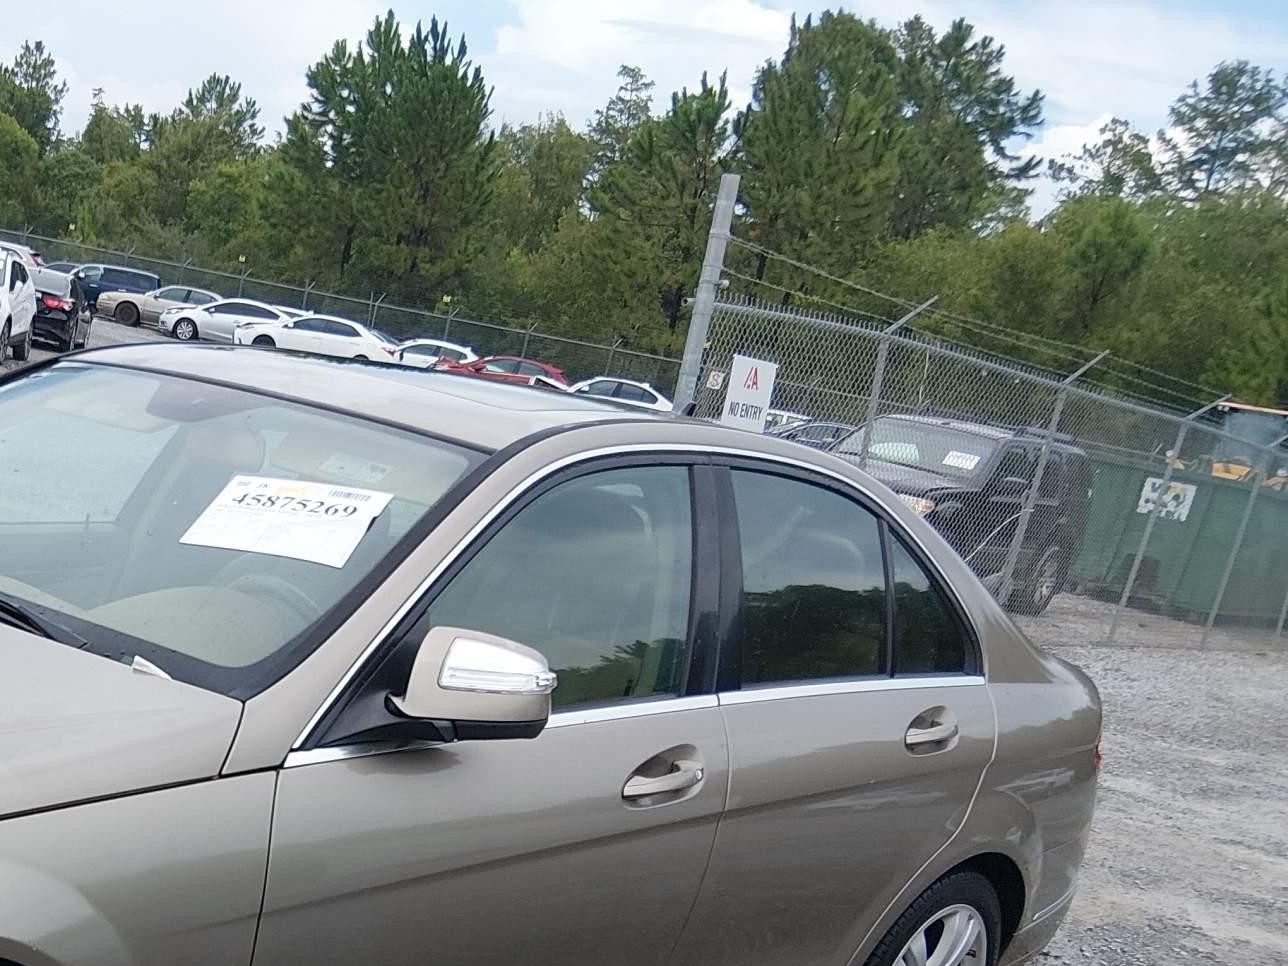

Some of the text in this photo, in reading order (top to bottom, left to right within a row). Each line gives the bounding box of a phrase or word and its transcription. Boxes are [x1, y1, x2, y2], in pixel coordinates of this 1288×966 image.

[728, 401, 763, 421] NO ENTRY
[232, 492, 358, 519] 45875269
